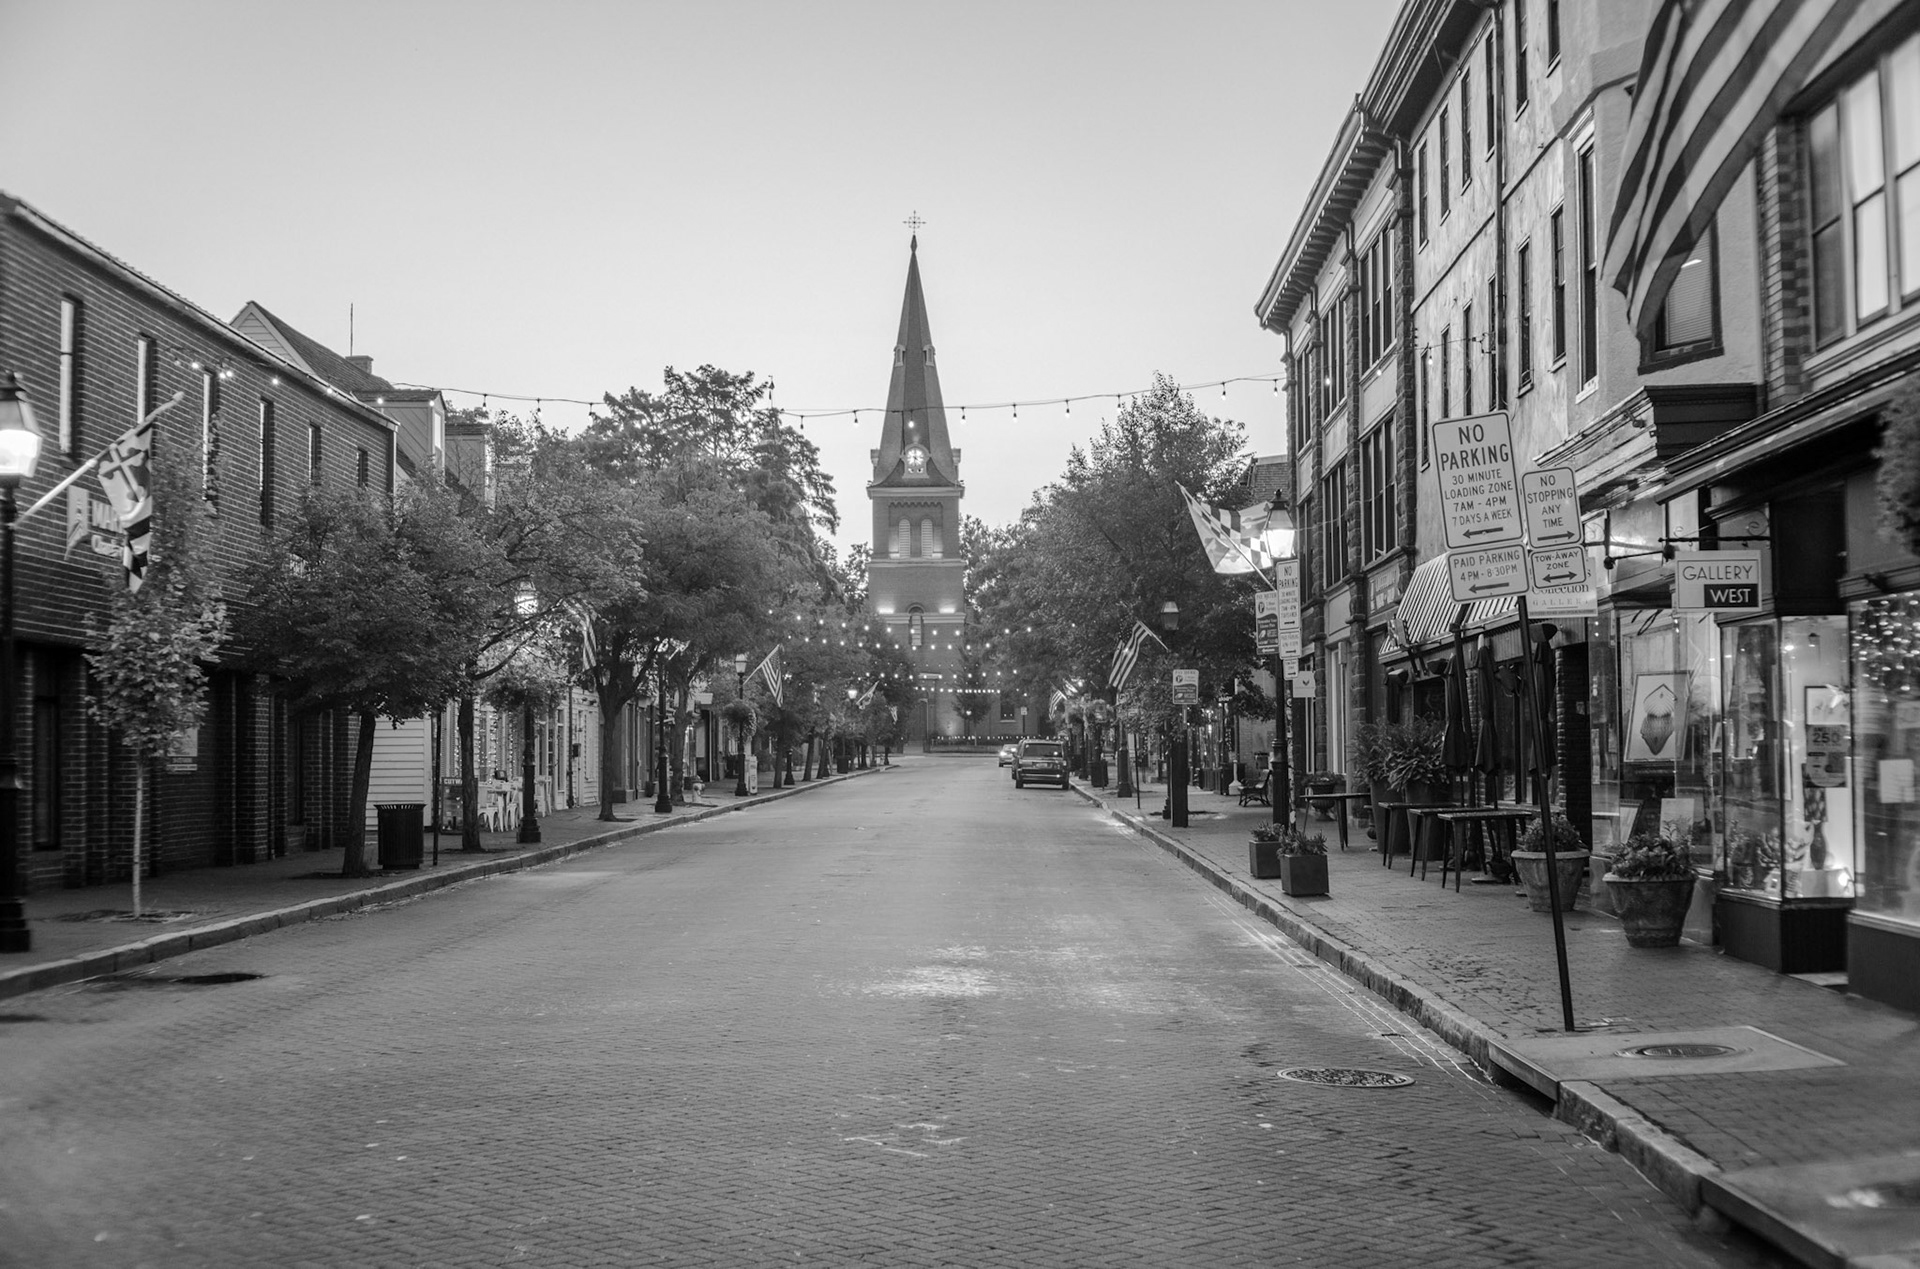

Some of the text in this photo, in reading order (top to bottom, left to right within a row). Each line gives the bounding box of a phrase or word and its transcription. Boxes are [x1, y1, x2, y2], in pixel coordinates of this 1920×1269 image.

[1458, 424, 1484, 445] NO
[1440, 443, 1509, 471] PARKING
[1452, 468, 1502, 485] 30 MINUTE
[1540, 475, 1556, 487] NO
[1444, 480, 1513, 500] LOADING ZONE
[1527, 487, 1573, 504] STOPPING
[1453, 500, 1474, 512] 7AM
[1485, 496, 1507, 507] 4PM
[1542, 504, 1561, 515] ANY
[1452, 508, 1513, 526] 7 DAYS A WEEK
[1543, 517, 1564, 528] TIME
[1454, 550, 1520, 568] PAID PARKING
[1535, 551, 1580, 562] TOW-AWAY
[1284, 566, 1292, 576] NO
[1487, 564, 1518, 578] 8:30PM
[1546, 561, 1570, 570] ZONE
[1682, 565, 1753, 581] GALLERY
[1710, 588, 1752, 603] WEST
